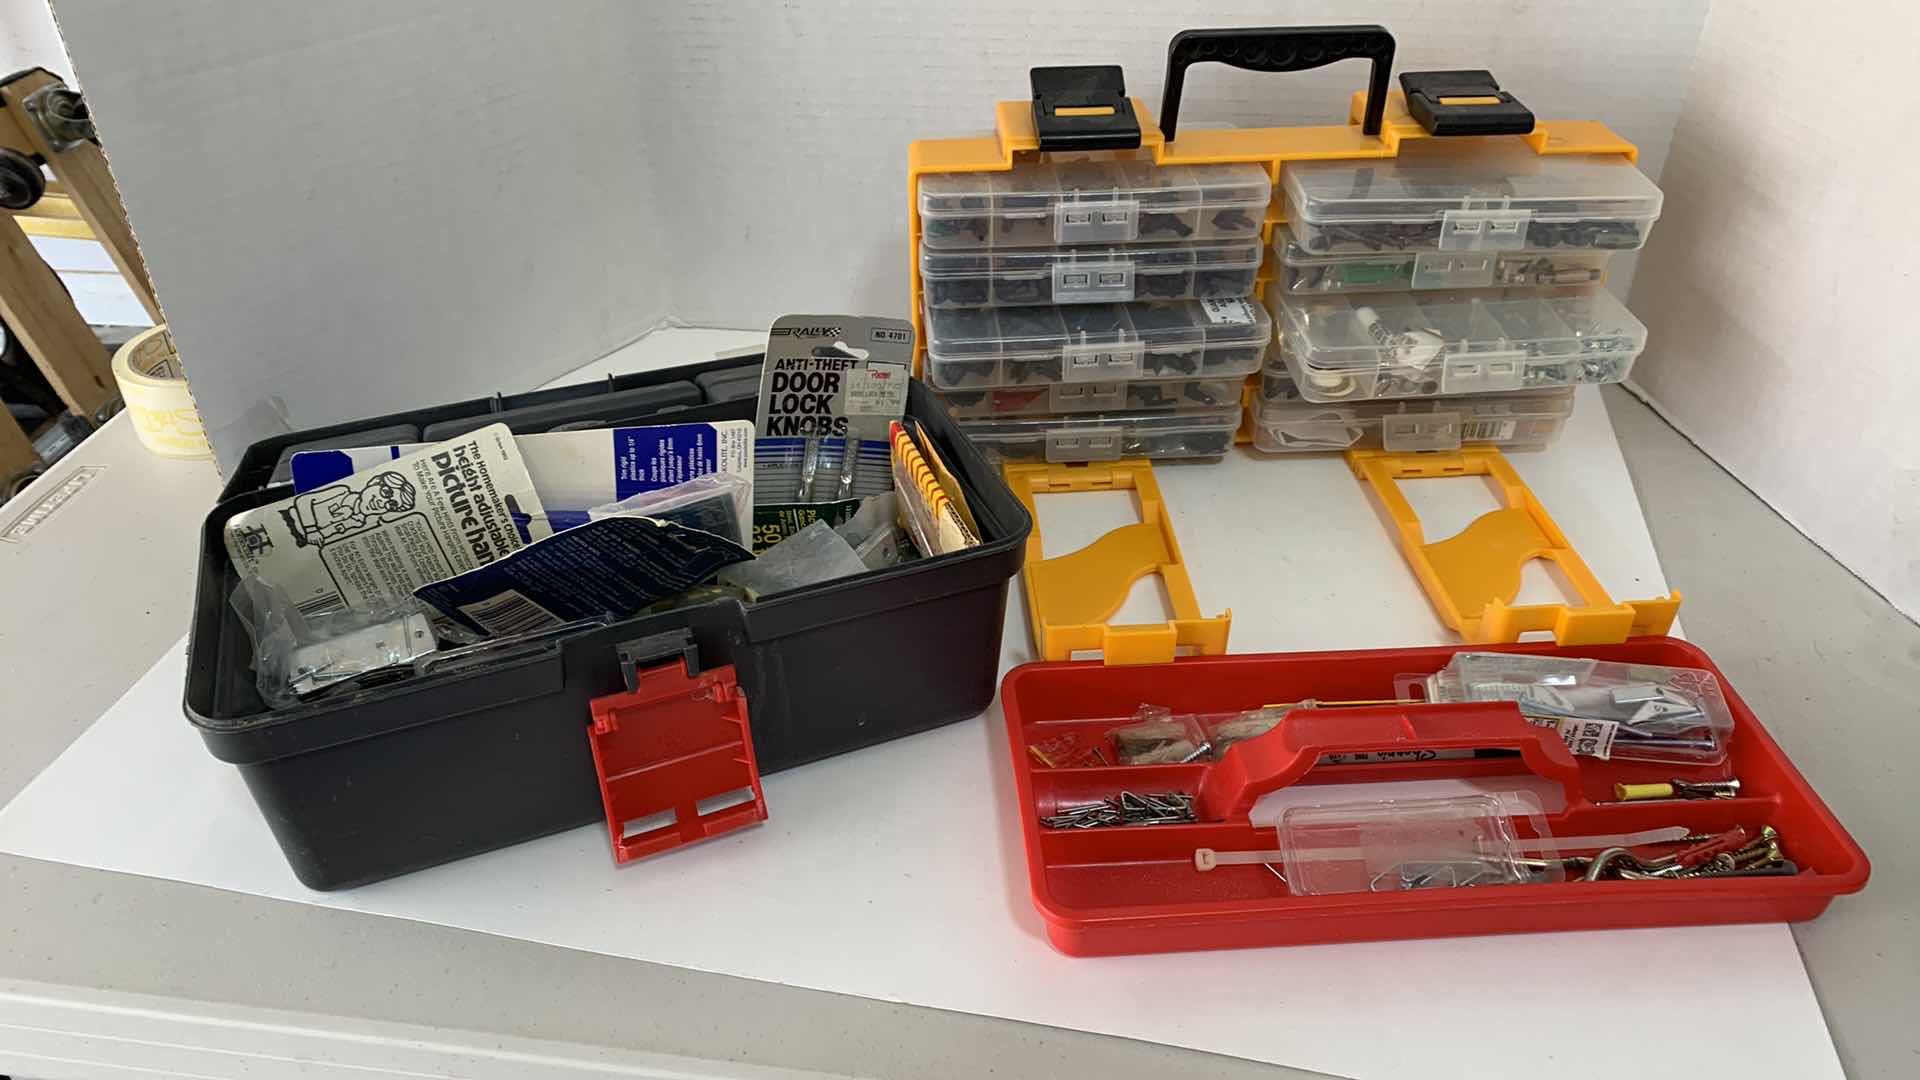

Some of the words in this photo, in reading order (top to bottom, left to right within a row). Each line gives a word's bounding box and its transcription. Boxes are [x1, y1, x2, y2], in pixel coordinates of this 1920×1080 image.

[774, 358, 859, 371] ANTI-THEFT
[771, 372, 840, 393] DOOR
[768, 394, 834, 415] LOCK
[765, 416, 850, 437] KNOBS
[467, 440, 482, 459] The
[476, 460, 509, 523] Homemaker's
[431, 450, 480, 530] picture
[465, 527, 497, 566] han
[452, 444, 482, 492] height
[472, 491, 511, 556] adjustable
[761, 524, 781, 543] 50
